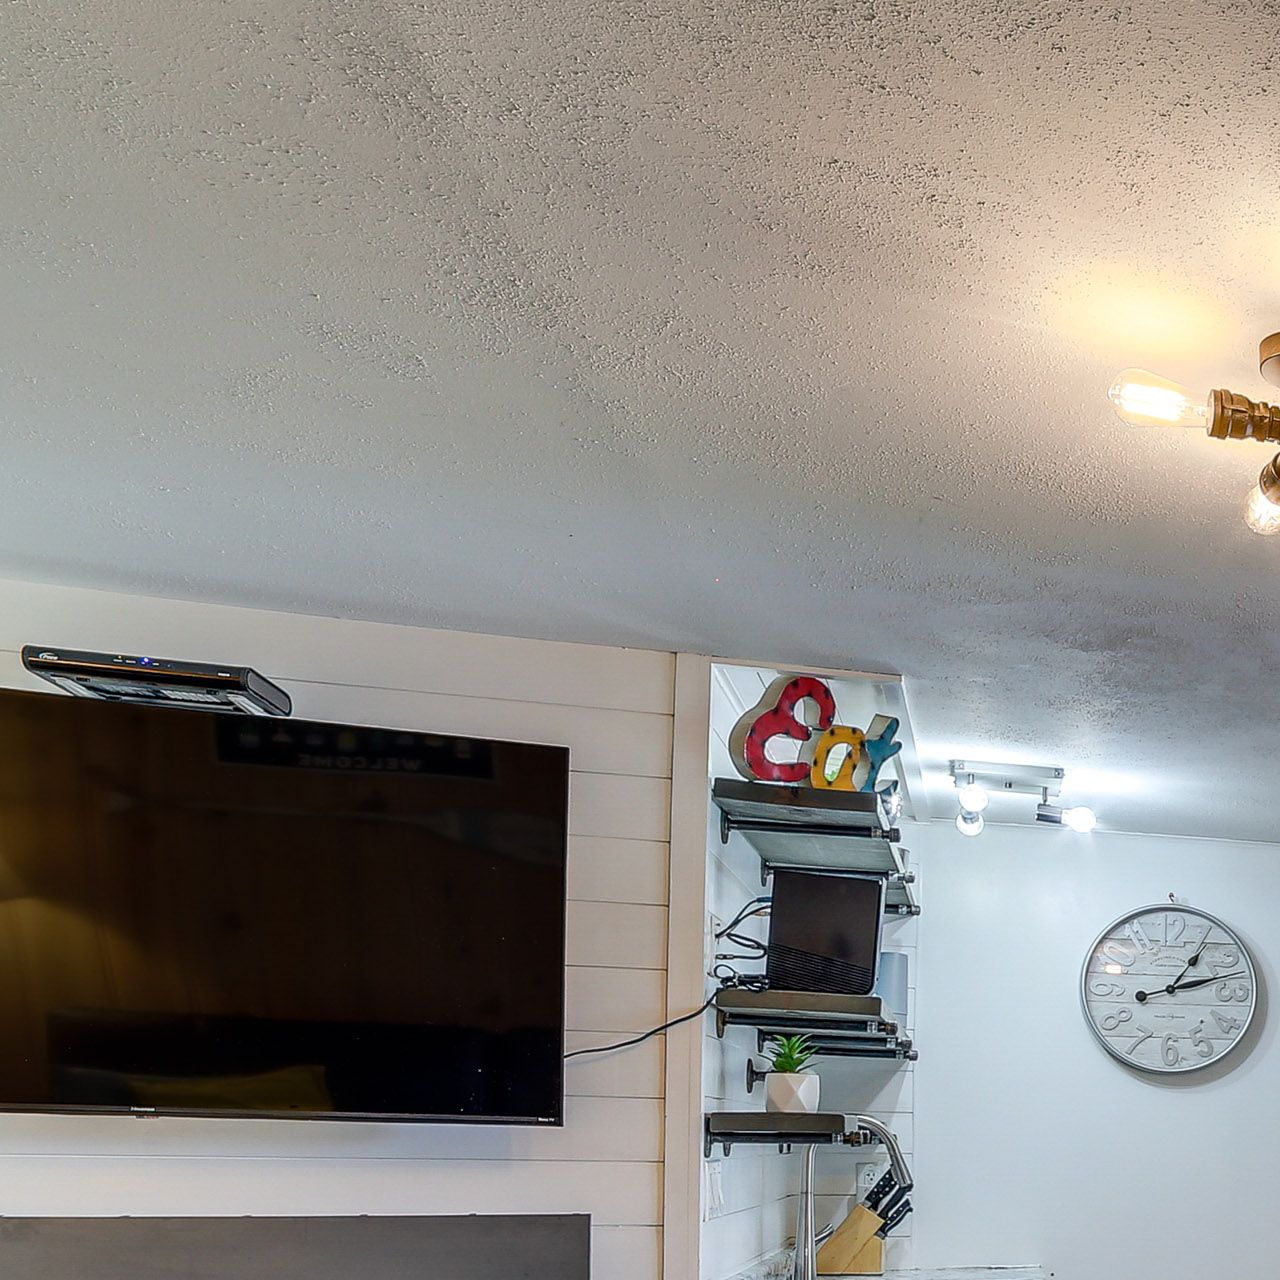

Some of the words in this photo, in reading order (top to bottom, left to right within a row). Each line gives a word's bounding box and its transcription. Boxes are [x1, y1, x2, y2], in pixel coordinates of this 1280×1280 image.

[1161, 914, 1186, 947] 12
[1205, 950, 1240, 977] 2
[1090, 983, 1125, 997] 9
[1215, 983, 1249, 1002] 3
[1101, 1007, 1132, 1030] 8
[1210, 1009, 1241, 1034] 4
[1125, 1023, 1153, 1055] 7
[1161, 1032, 1179, 1066] 6
[1189, 1024, 1213, 1058] 5
